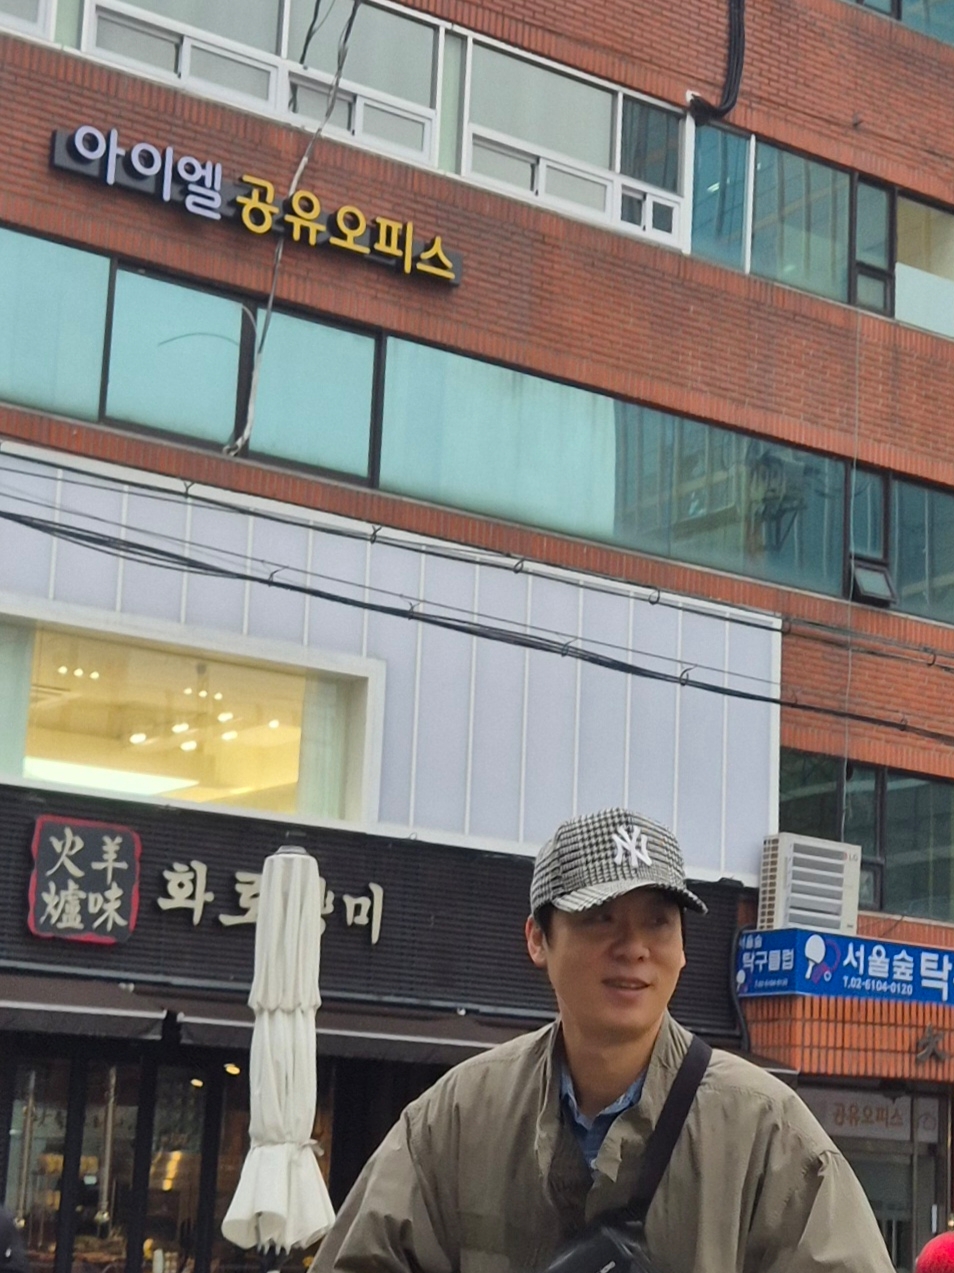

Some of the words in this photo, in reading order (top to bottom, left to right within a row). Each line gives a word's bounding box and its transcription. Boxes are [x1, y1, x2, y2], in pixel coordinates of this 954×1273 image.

[74, 125, 222, 220] 아이엘
[236, 174, 456, 280] 공유오피스
[611, 825, 653, 868] NY
[742, 948, 795, 974] 탁구클럽
[843, 942, 914, 982] 서울숲
[833, 1102, 904, 1128] 공유오피스
